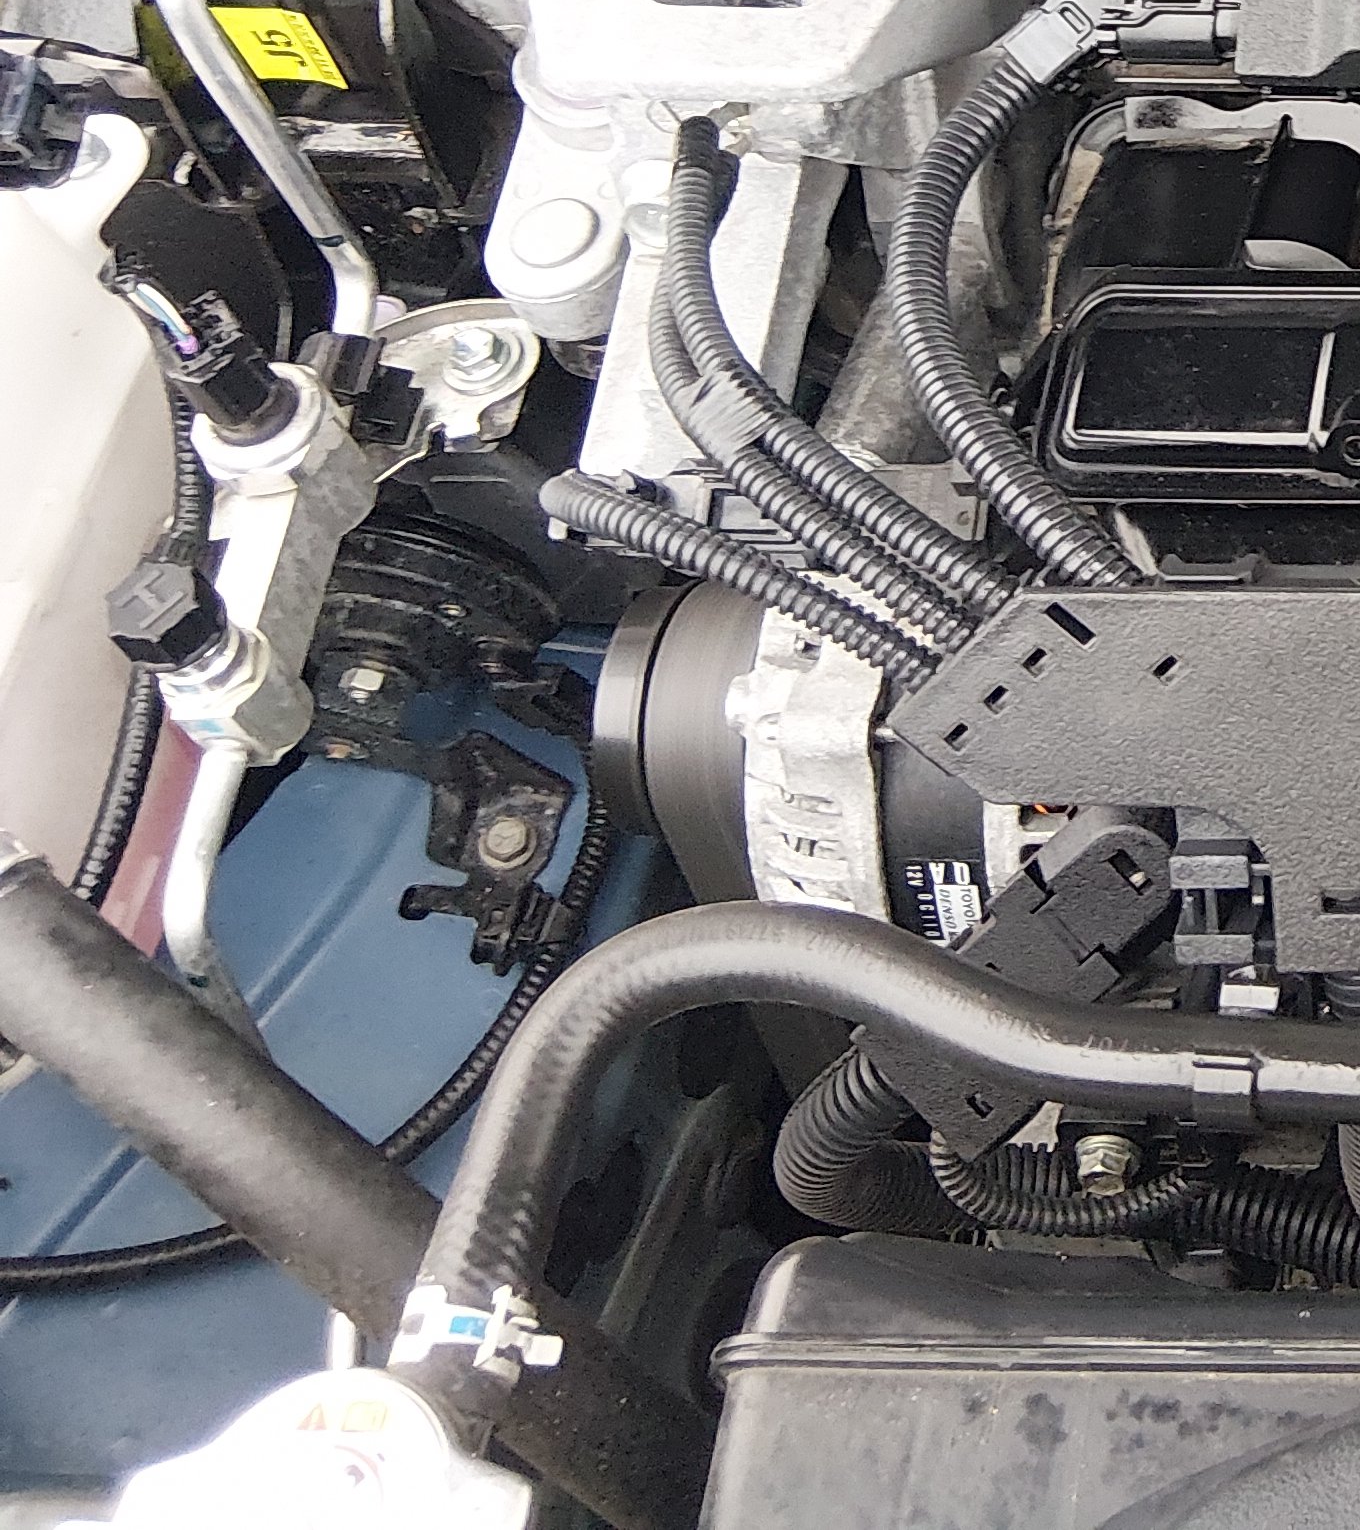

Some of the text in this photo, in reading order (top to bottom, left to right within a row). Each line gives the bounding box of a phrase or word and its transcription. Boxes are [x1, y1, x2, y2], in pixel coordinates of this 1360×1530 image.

[250, 30, 309, 67] J5
[904, 865, 925, 887] 12V
[938, 888, 958, 930] DENSO
